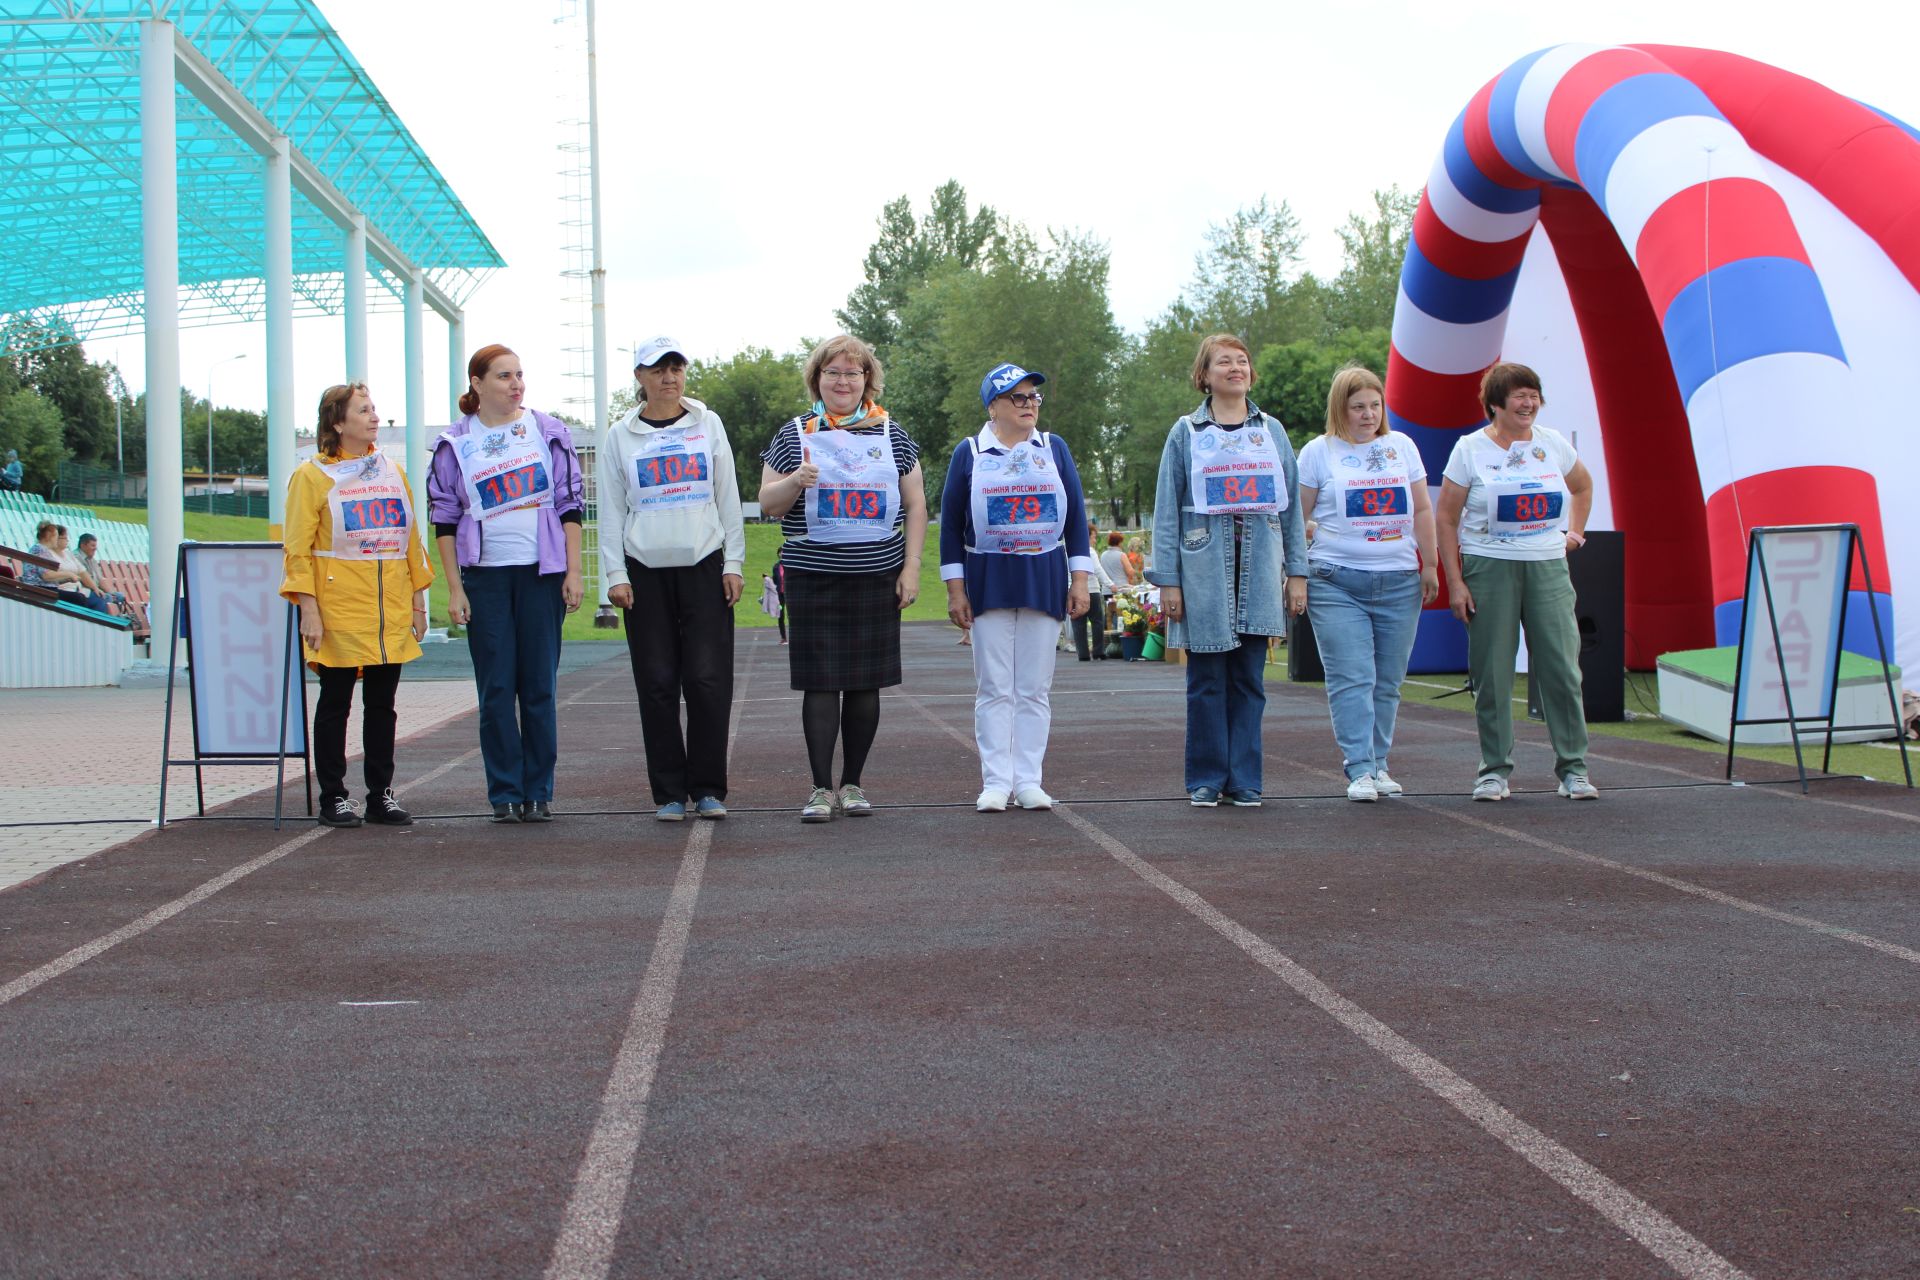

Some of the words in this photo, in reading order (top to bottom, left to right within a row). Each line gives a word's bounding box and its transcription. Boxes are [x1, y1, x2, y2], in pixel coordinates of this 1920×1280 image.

[470, 466, 497, 484] ЛЫЖНЯ
[497, 457, 523, 472] РОССИИ
[646, 454, 701, 485] 104
[1202, 465, 1230, 474] ЛЫЖНЯ
[1232, 463, 1257, 471] РОССИИ
[339, 486, 367, 497] ЛЫЖНЯ
[486, 465, 537, 504] 107
[662, 485, 692, 495] ЗАИНСК
[982, 485, 1010, 495] ЛЫЖНЯ
[1011, 484, 1038, 493] РОССИИ
[1223, 476, 1260, 503] 84
[1348, 479, 1375, 487] ЛЫЖНЯ
[1377, 478, 1399, 486] РОССИИ
[352, 499, 401, 529] 105
[827, 490, 880, 518] 103
[1004, 496, 1042, 525] 79
[1363, 488, 1397, 515] 82
[1515, 493, 1549, 521] 80
[985, 529, 1023, 537] РЕСПУБЛИКА
[1520, 522, 1548, 531] ЗАИНСК
